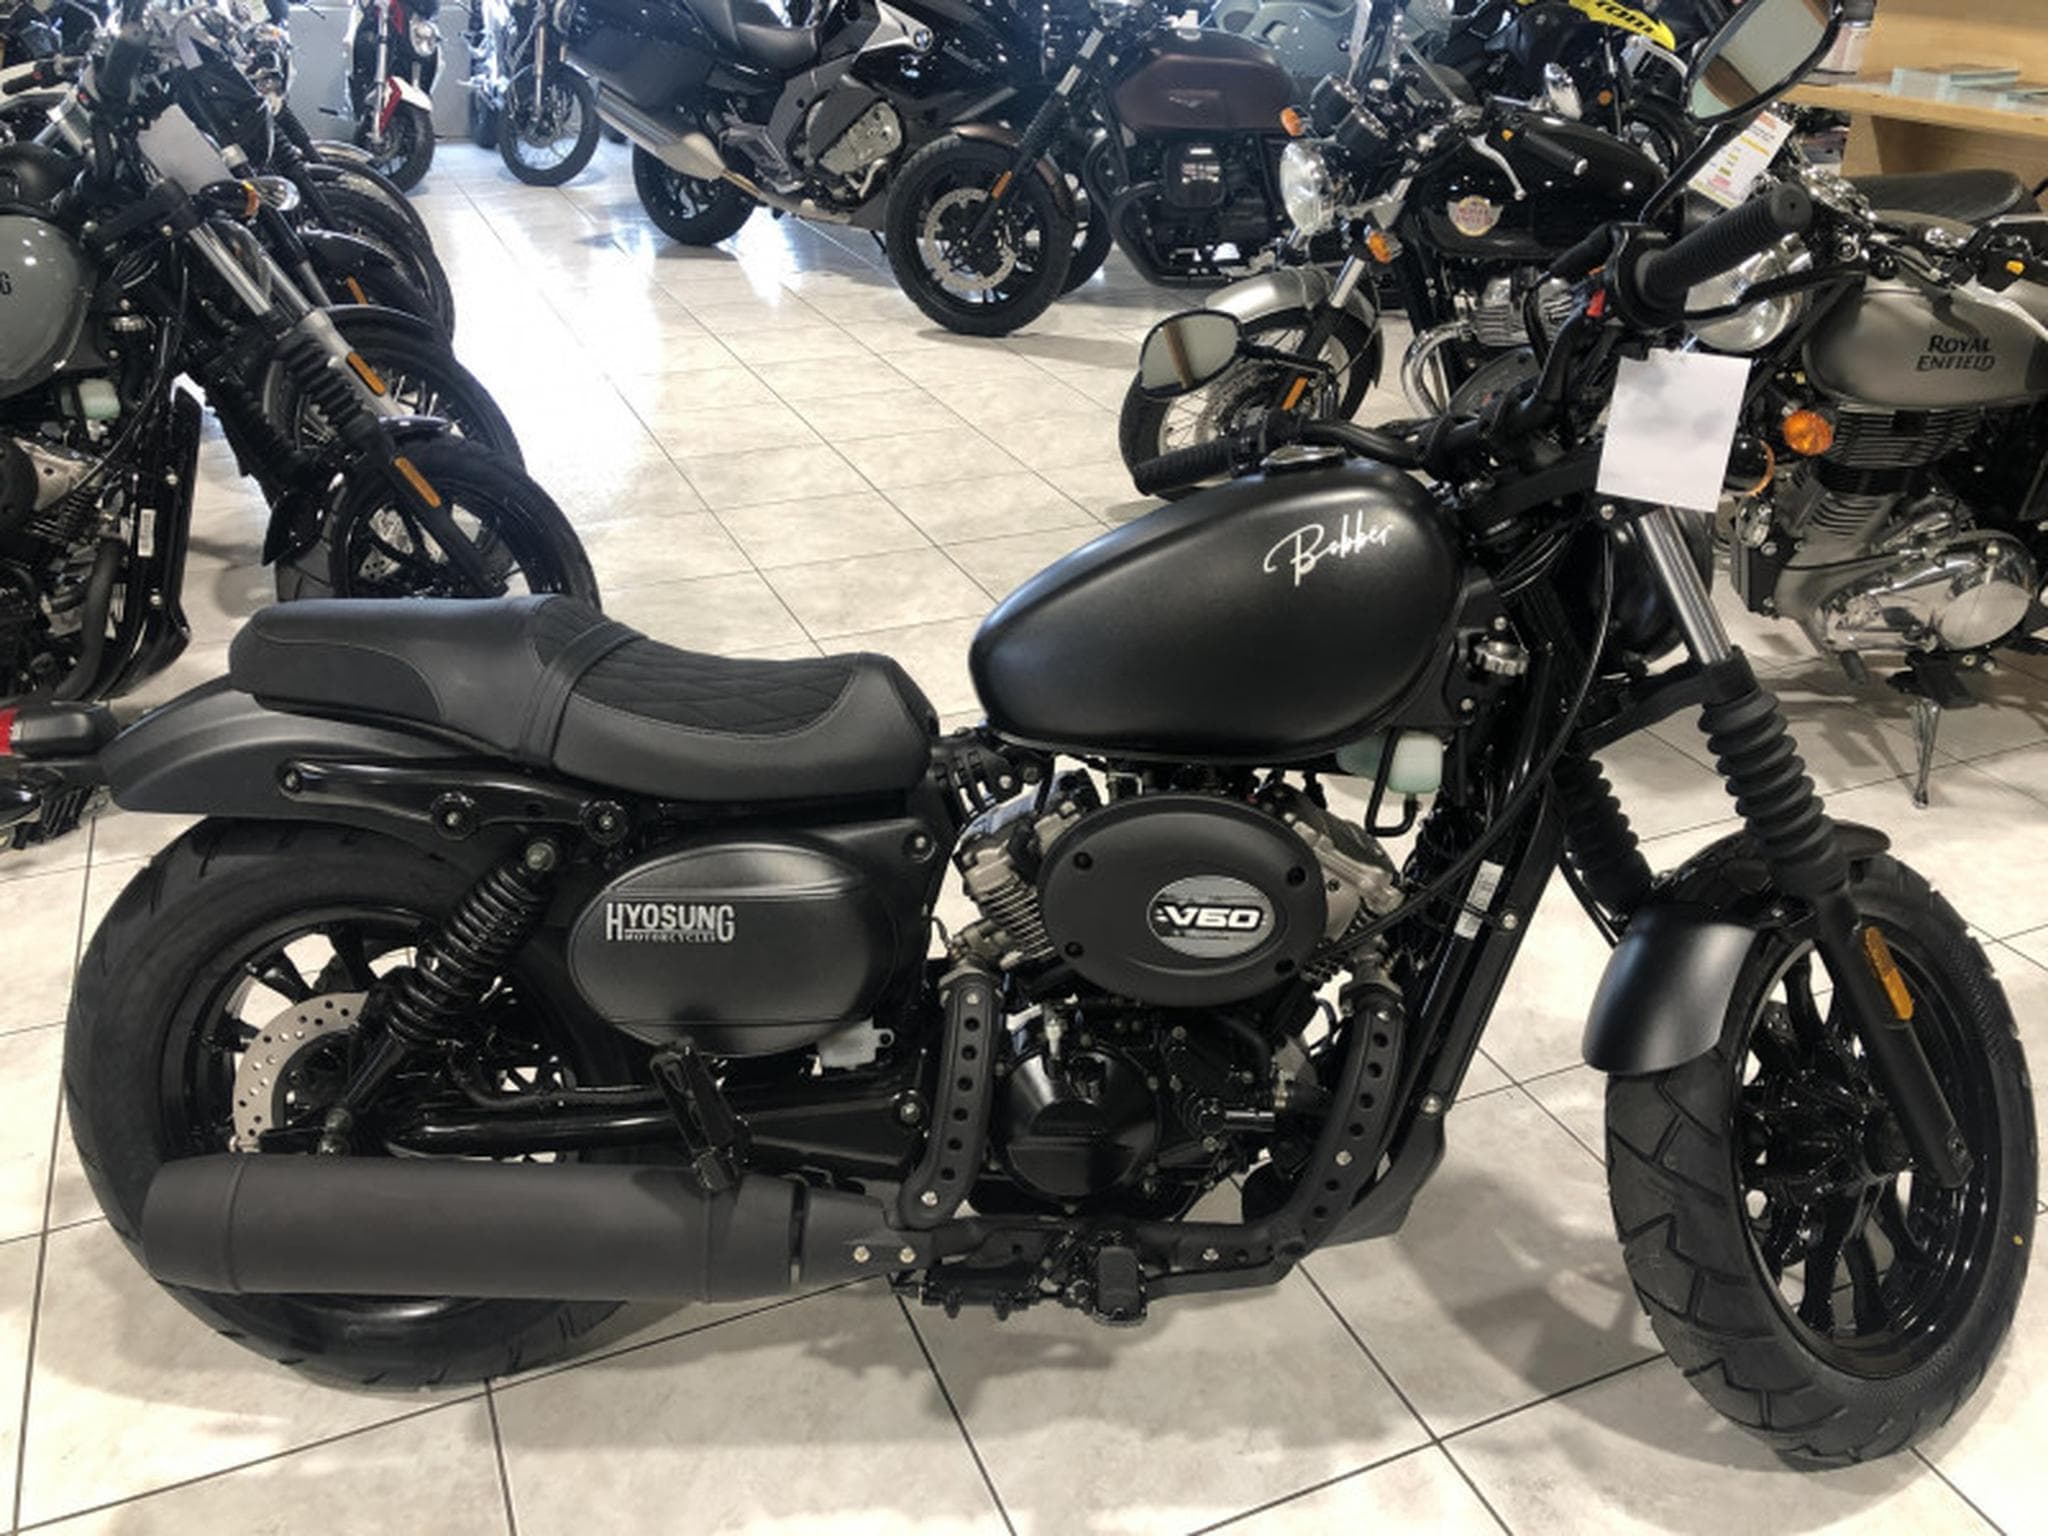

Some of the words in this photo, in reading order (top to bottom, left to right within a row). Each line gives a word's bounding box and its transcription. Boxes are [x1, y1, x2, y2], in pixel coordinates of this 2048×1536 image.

[1916, 355, 1996, 372] ENFIELD
[1263, 508, 1393, 587] Bobber
[606, 902, 735, 942] HYOSUNG
